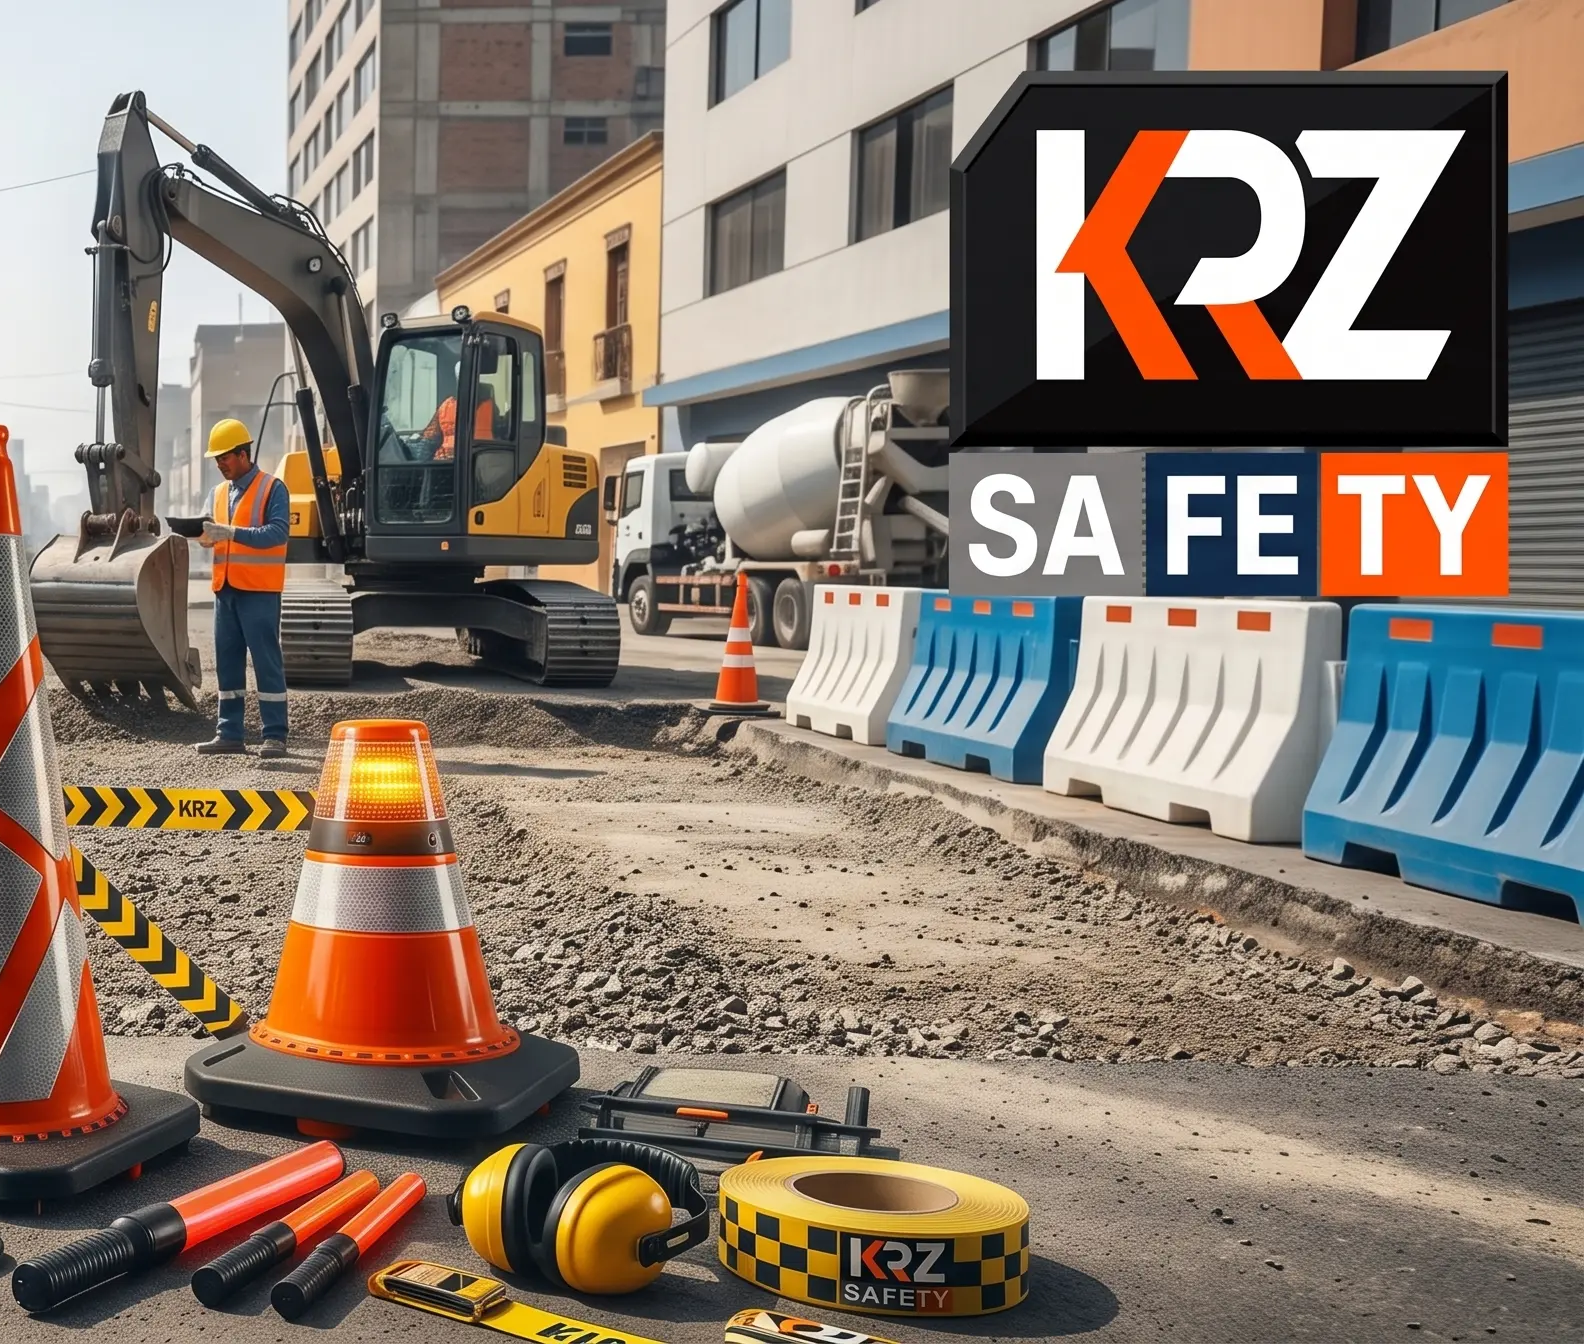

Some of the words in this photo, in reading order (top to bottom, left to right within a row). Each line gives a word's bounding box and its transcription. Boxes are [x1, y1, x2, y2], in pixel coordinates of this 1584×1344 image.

[179, 799, 218, 818] KRZ
[850, 1237, 946, 1283] KRZ
[844, 1283, 949, 1309] SAFETY
